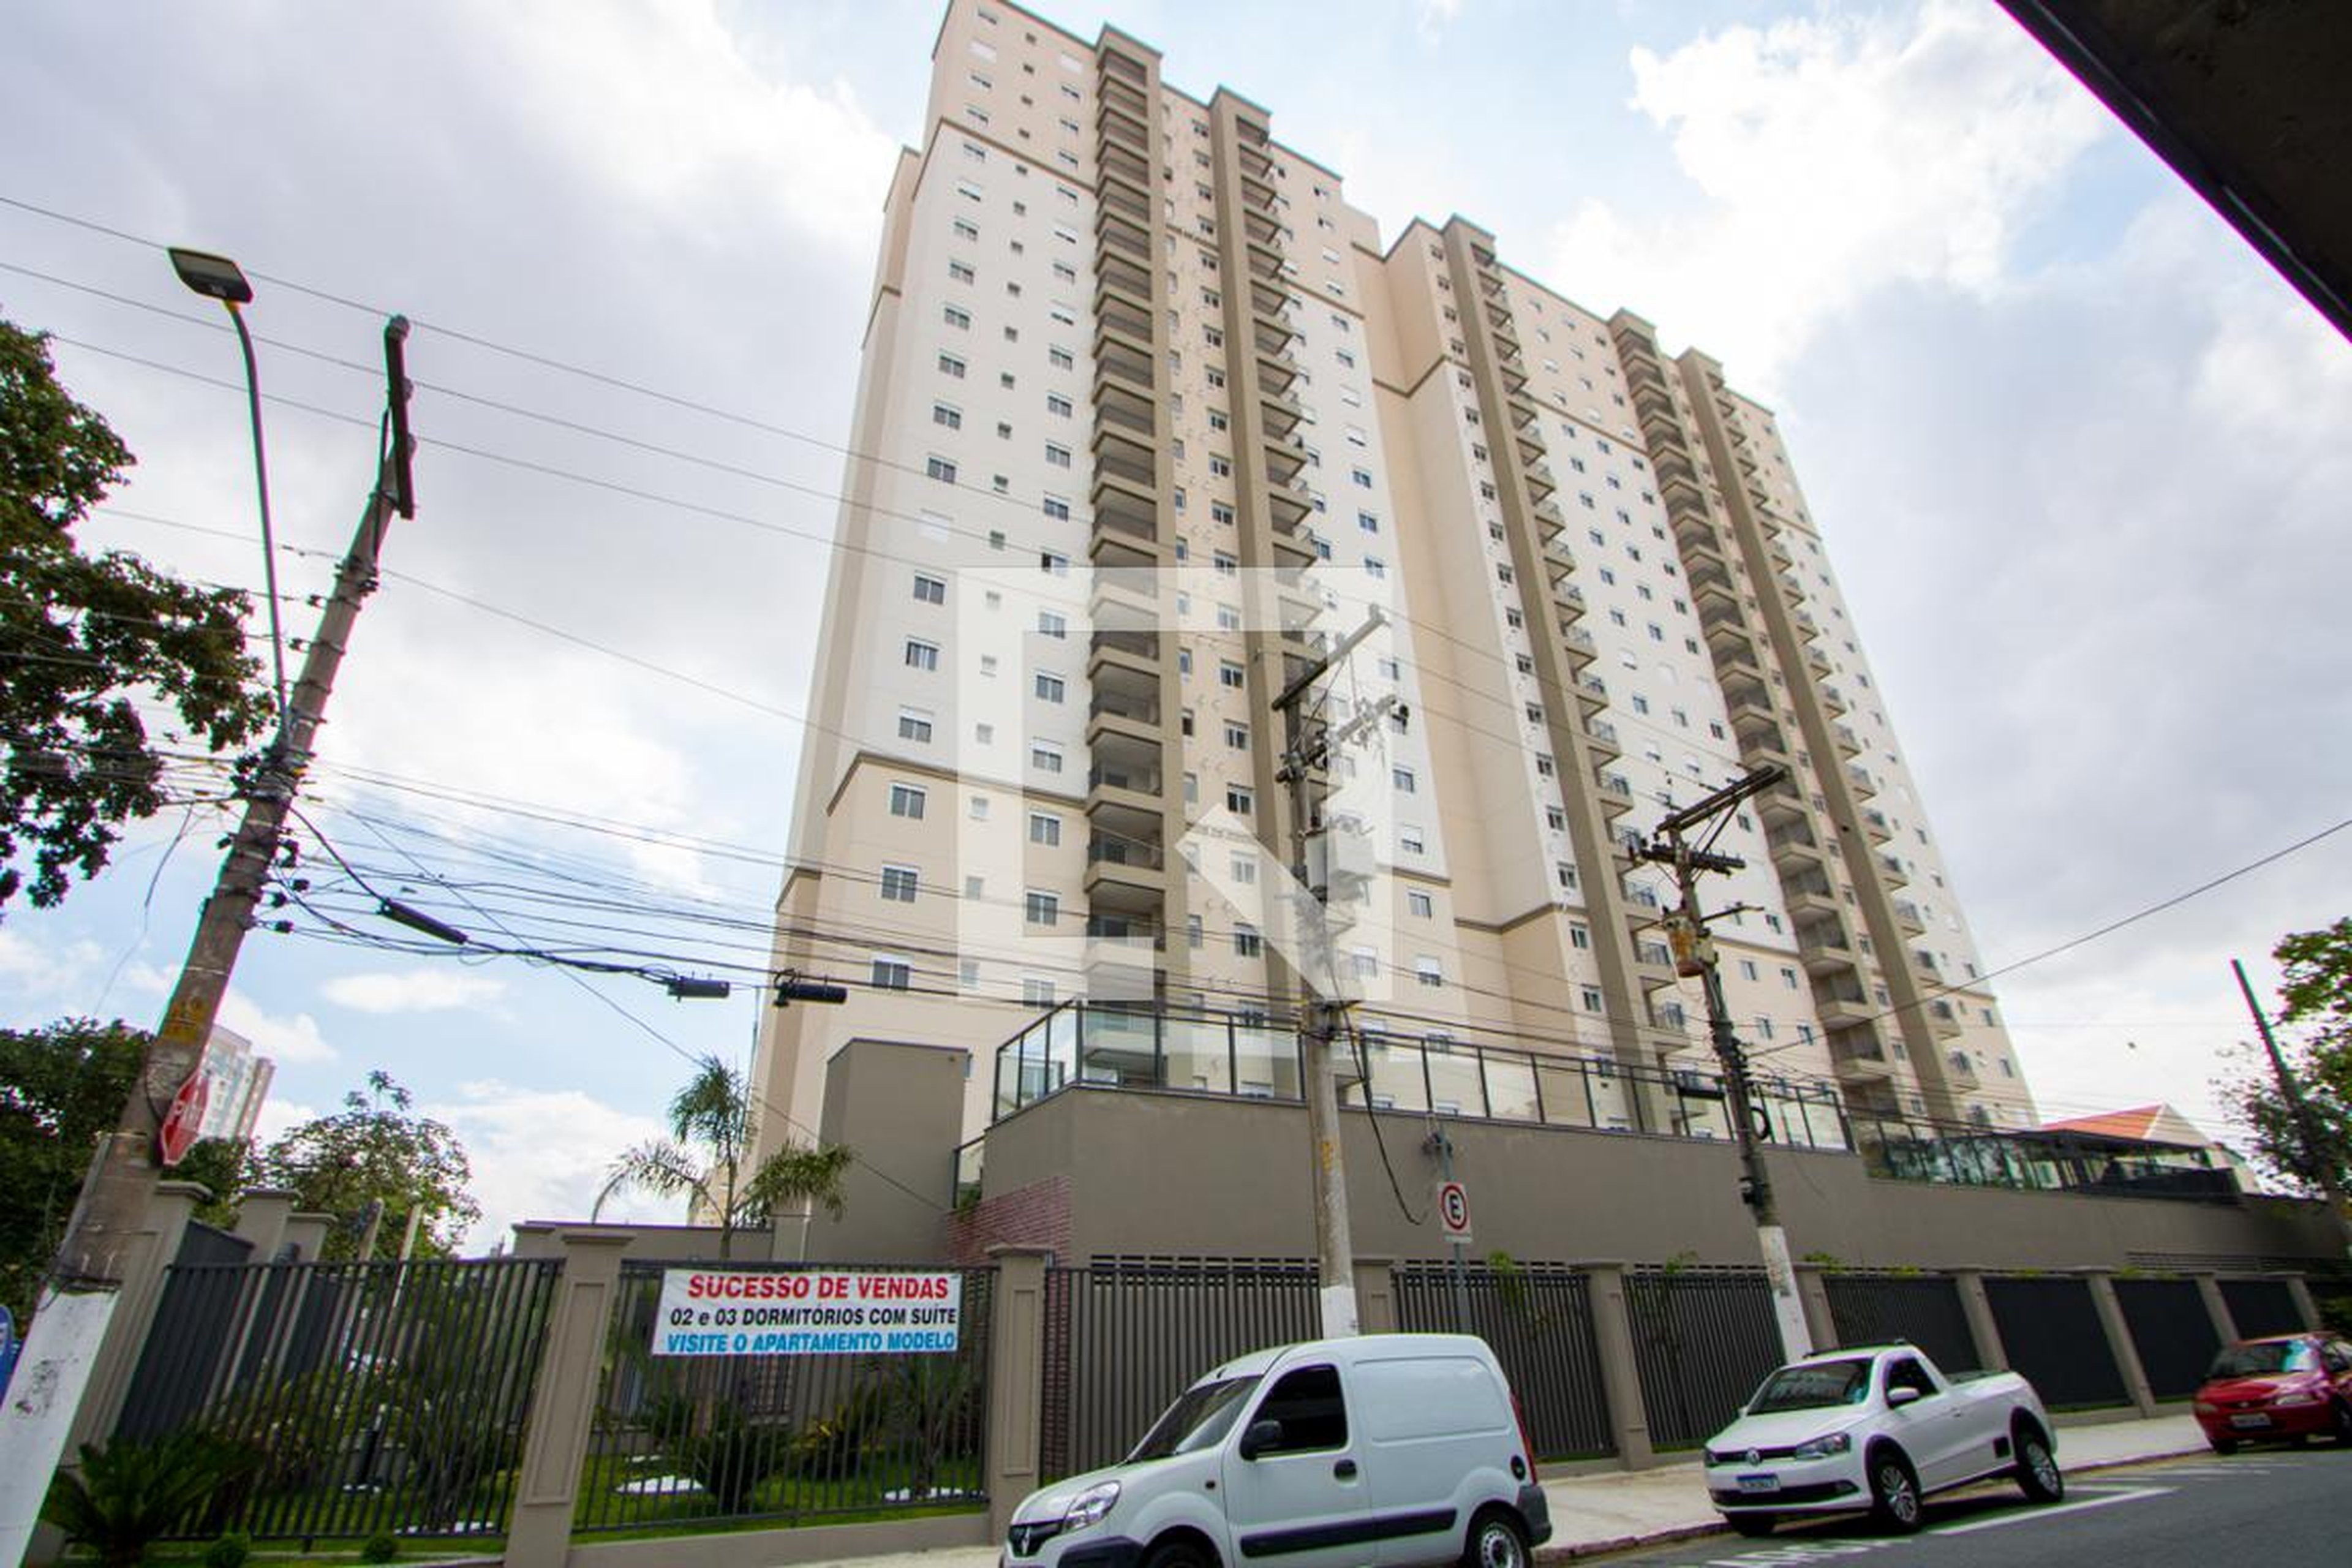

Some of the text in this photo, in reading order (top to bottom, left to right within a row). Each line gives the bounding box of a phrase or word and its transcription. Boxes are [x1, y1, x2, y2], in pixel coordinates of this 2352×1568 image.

[1449, 1194, 1461, 1221] E
[688, 1275, 949, 1299] SUCESSO DE VENDAS
[671, 1308, 693, 1325] 02
[698, 1311, 710, 1325] e
[715, 1308, 737, 1325] 03
[869, 1308, 906, 1324] COM
[668, 1331, 956, 1352] VISITE O APARTAMENTO MODELO
